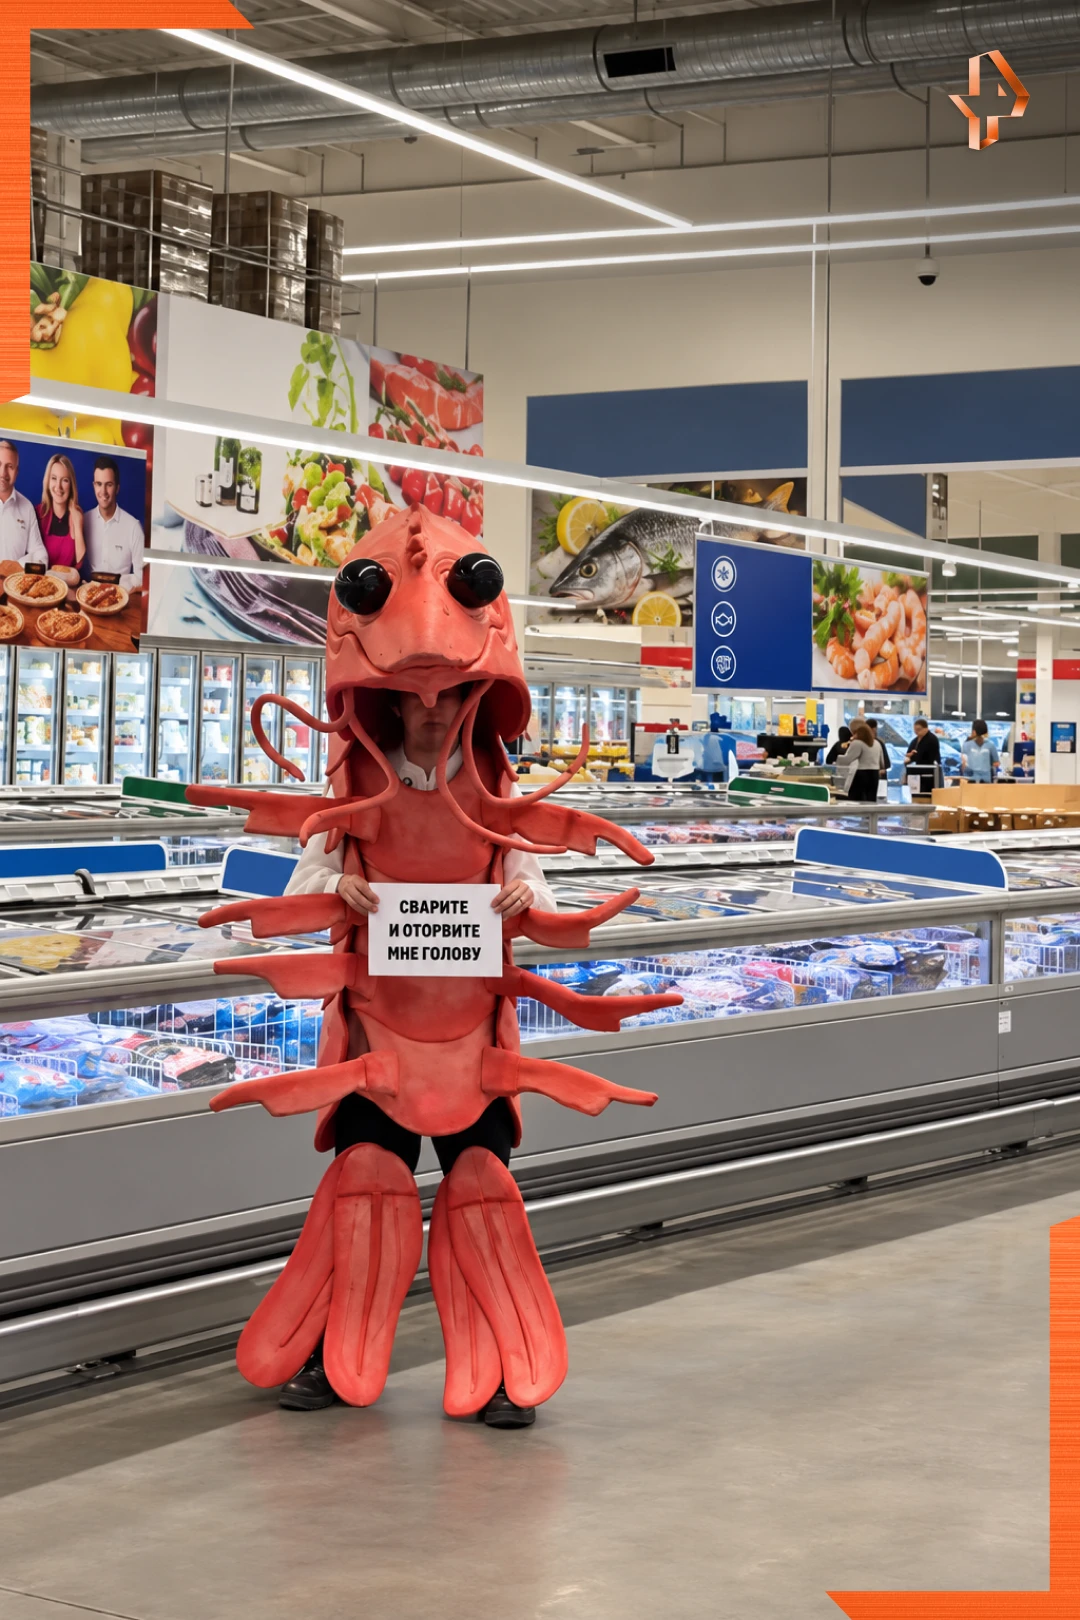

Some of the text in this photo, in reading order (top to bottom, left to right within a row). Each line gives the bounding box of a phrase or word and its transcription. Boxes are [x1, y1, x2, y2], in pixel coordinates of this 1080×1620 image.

[399, 900, 469, 914] СВАРИТЕ
[389, 923, 481, 938] И ОТОРВИТЕ
[387, 946, 482, 961] МНЕ ГОЛОВУ
